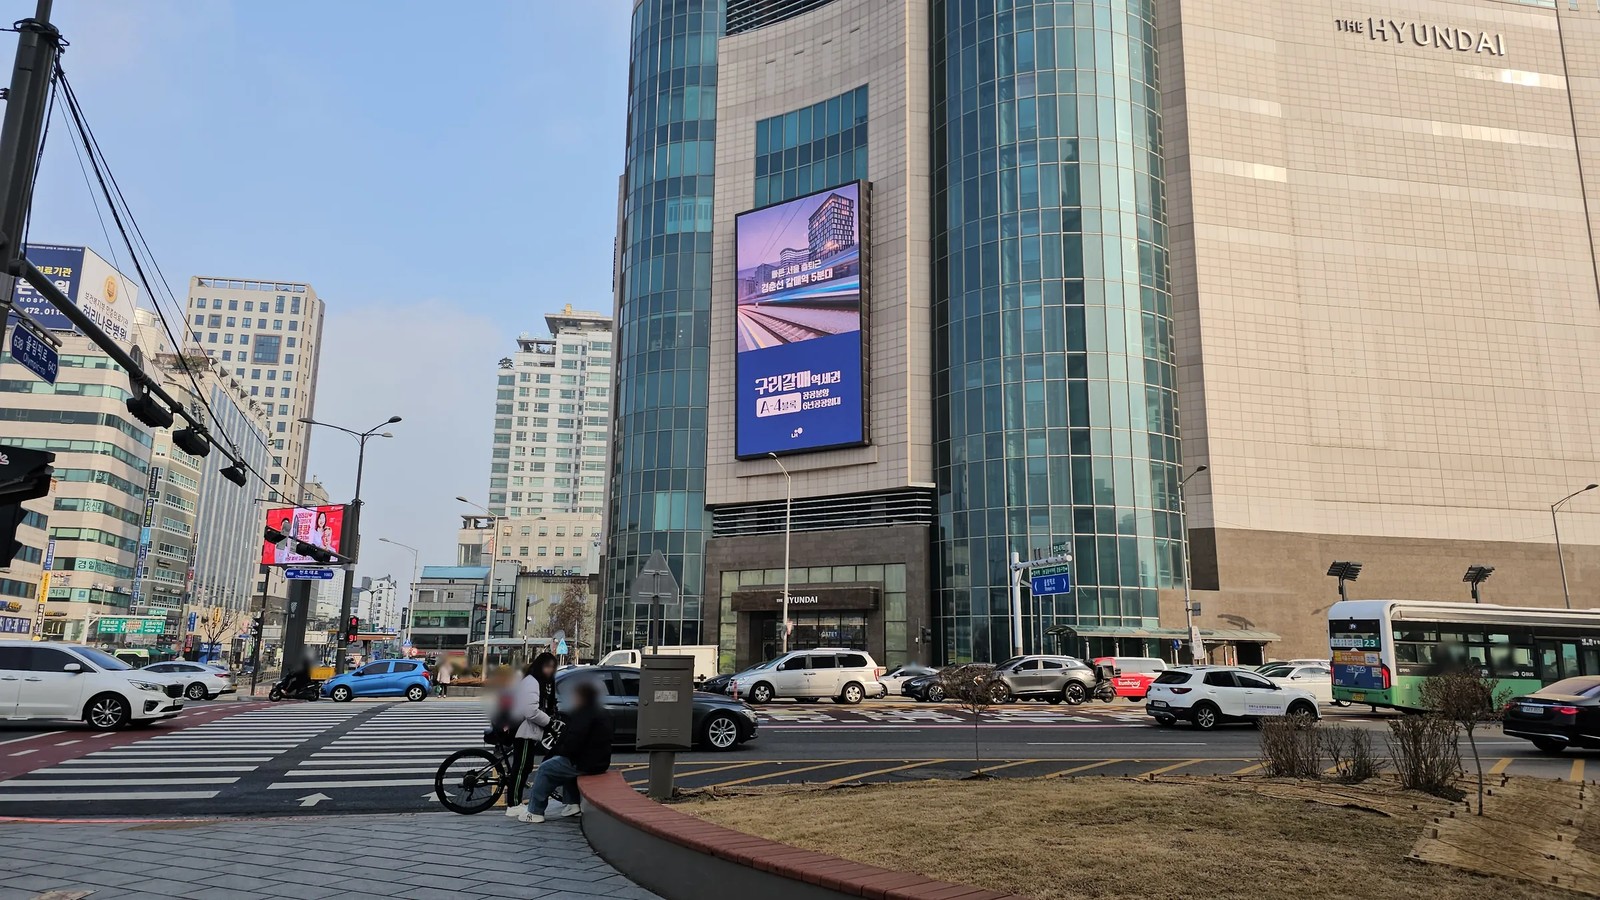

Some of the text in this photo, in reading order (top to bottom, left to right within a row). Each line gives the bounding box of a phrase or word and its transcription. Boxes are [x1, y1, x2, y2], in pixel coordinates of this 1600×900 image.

[1335, 17, 1506, 56] THE HYUNDAI
[25, 335, 48, 362] 올림픽로
[1363, 639, 1376, 648] 23
